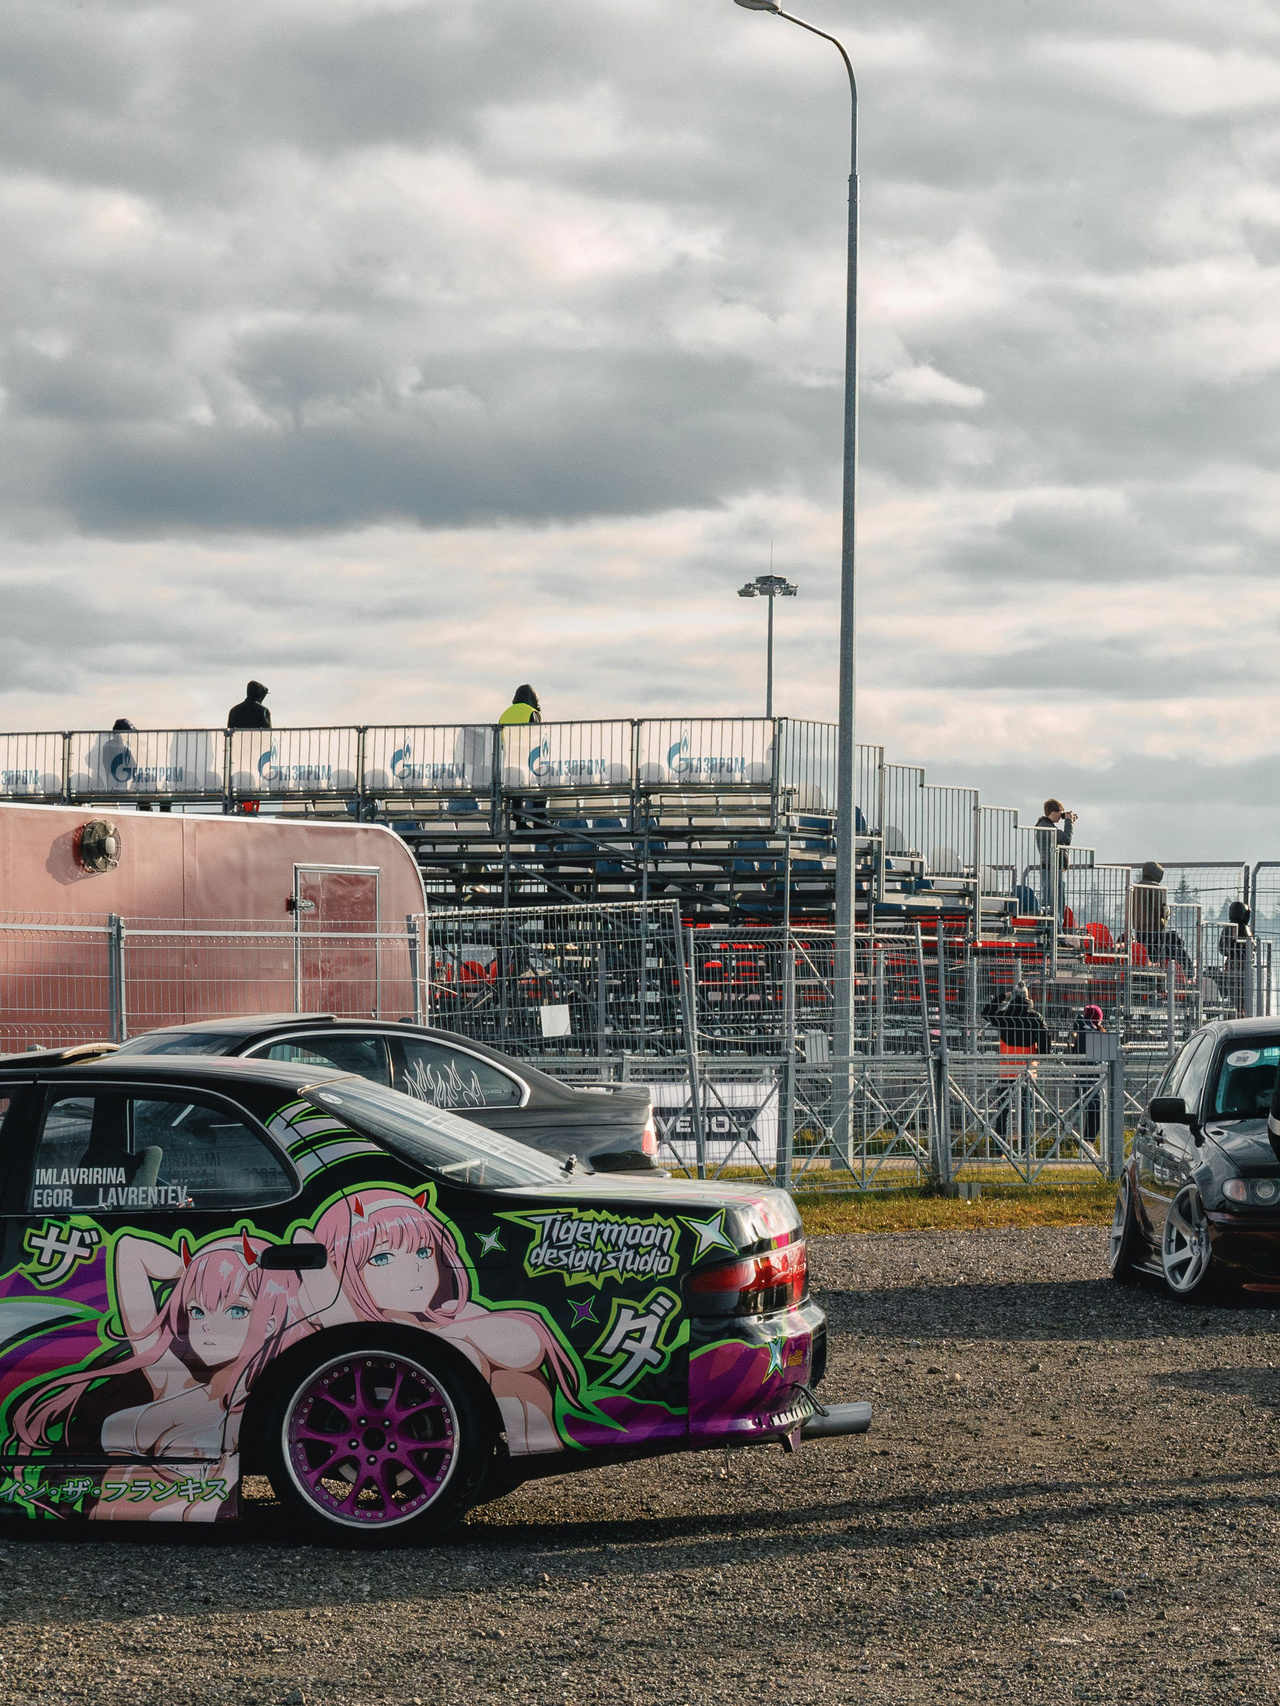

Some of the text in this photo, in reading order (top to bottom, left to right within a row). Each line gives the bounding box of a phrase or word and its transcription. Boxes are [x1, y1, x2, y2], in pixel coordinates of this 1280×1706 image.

[35, 1167, 126, 1186] IMLAVRIRINA
[527, 1212, 673, 1253] Tigermoon
[31, 1225, 99, 1284] ザ
[530, 1240, 671, 1277] design studio
[601, 1295, 673, 1386] ダ
